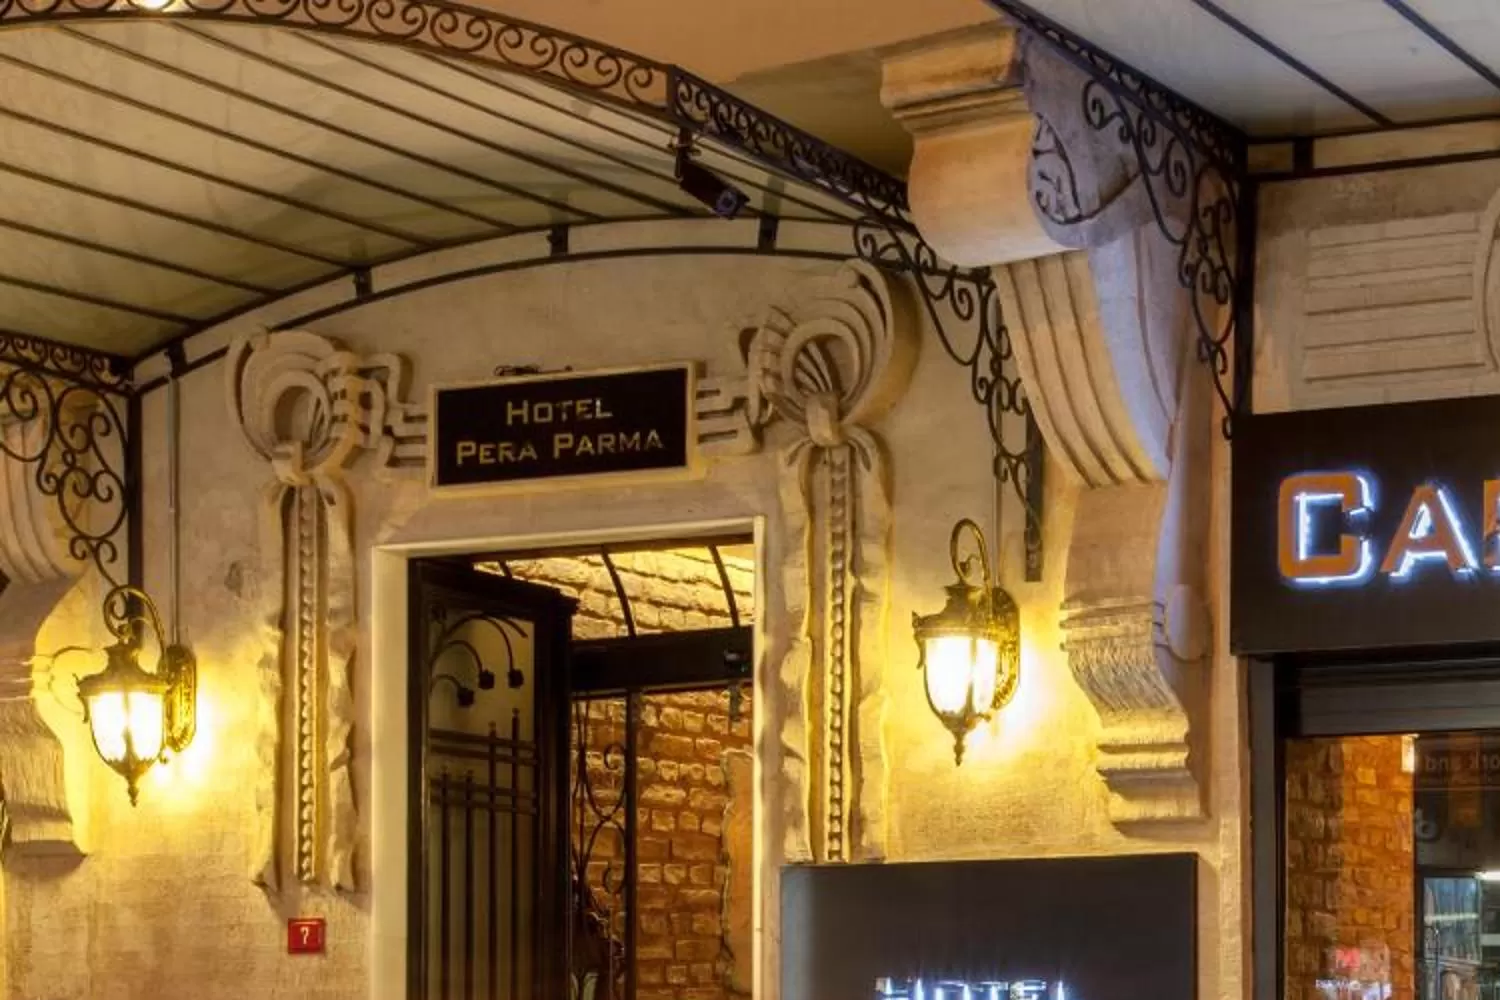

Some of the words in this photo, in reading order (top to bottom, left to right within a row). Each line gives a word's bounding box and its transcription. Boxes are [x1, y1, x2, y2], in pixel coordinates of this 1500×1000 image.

[507, 398, 613, 426] HOTEL
[456, 440, 538, 466] PERA
[552, 429, 665, 460] PARMA
